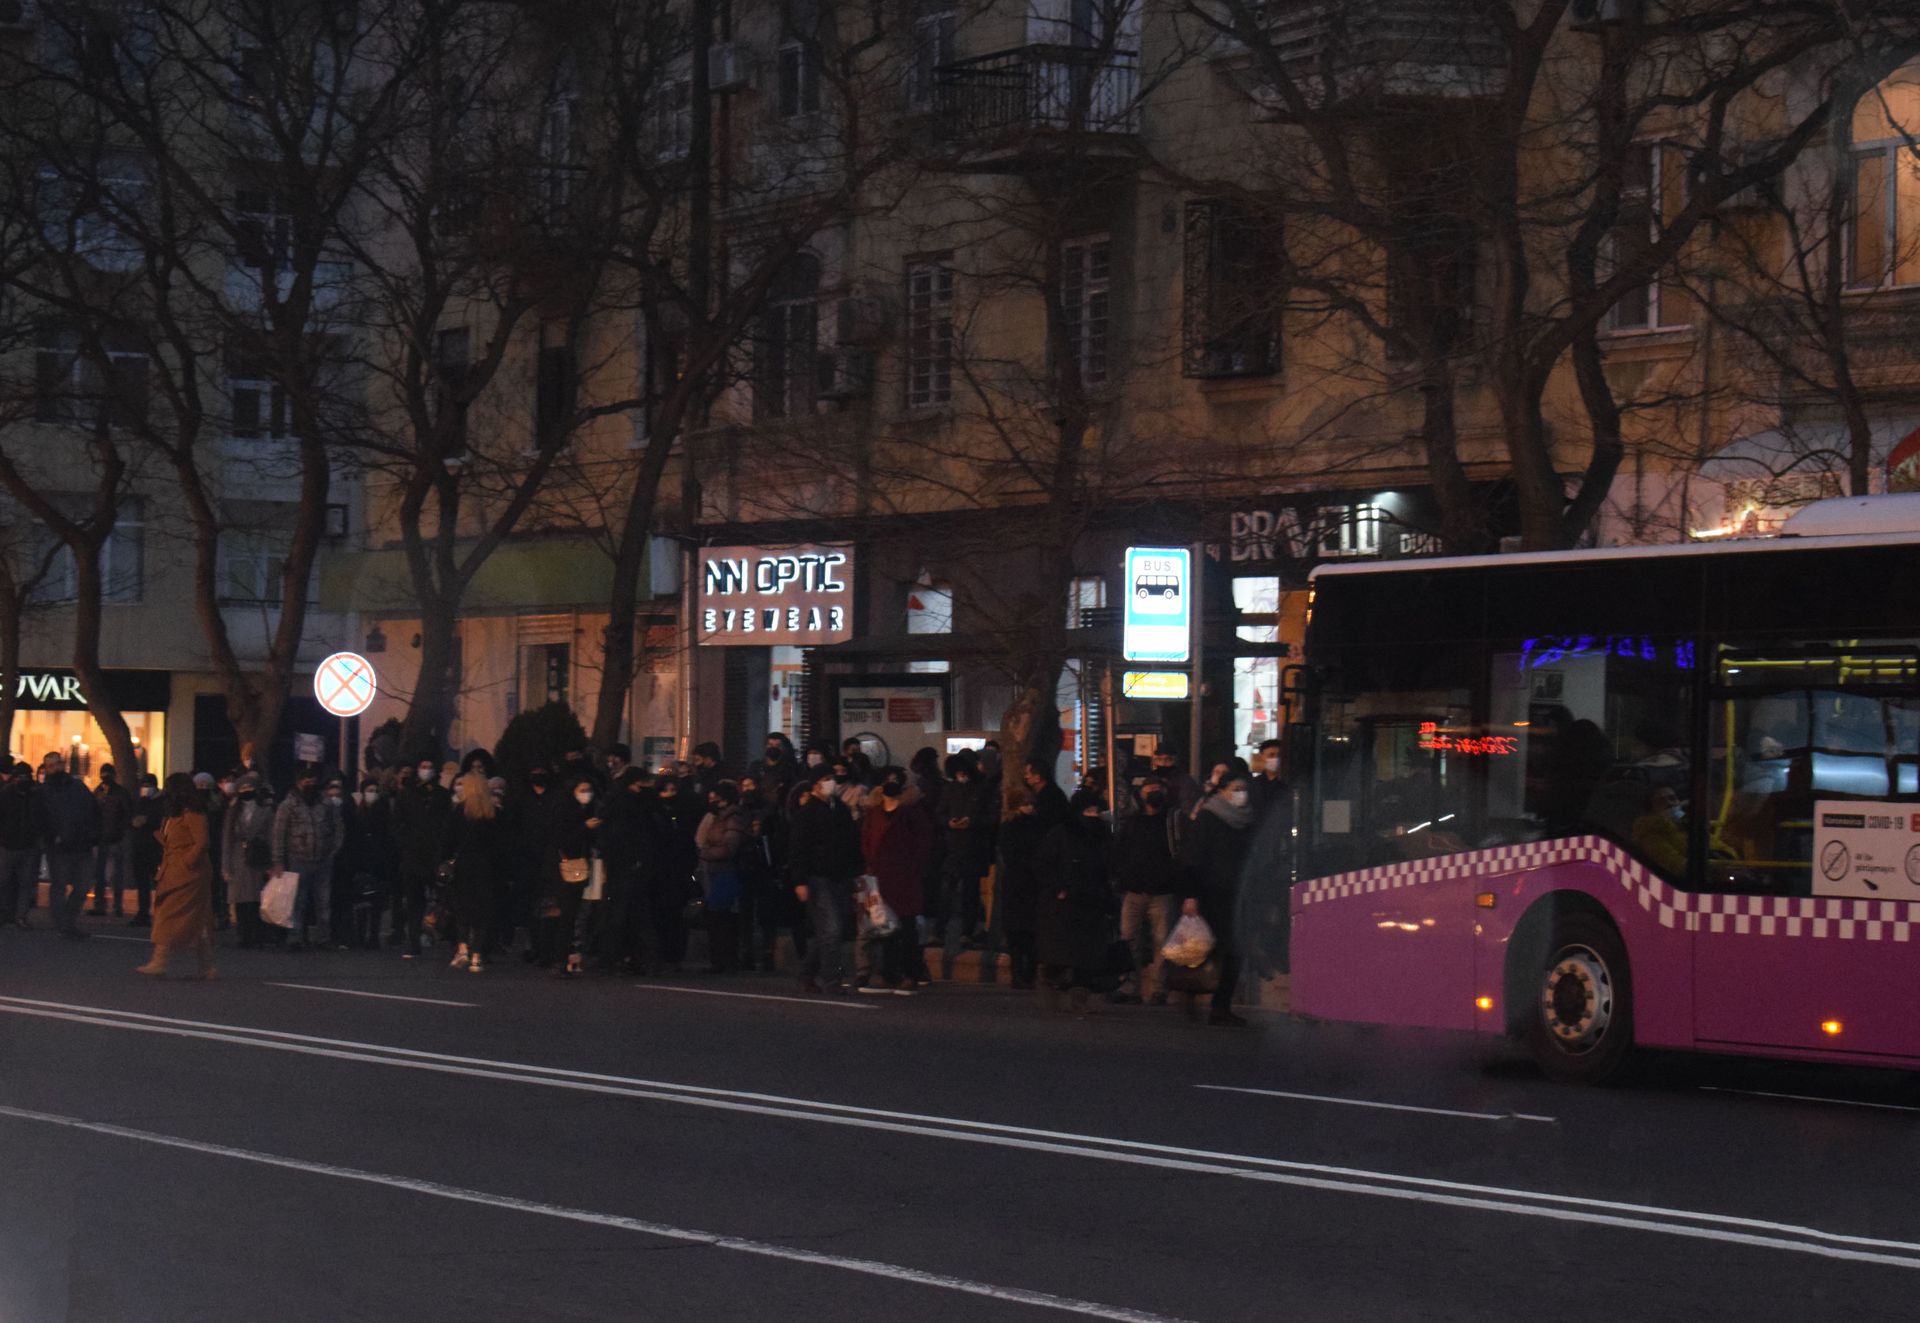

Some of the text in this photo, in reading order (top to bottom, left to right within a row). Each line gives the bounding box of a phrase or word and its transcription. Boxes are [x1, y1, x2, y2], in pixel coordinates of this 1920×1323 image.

[705, 553, 846, 595] NN OPTIC
[1143, 560, 1171, 571] BUS
[704, 605, 844, 632] EYEWEAR
